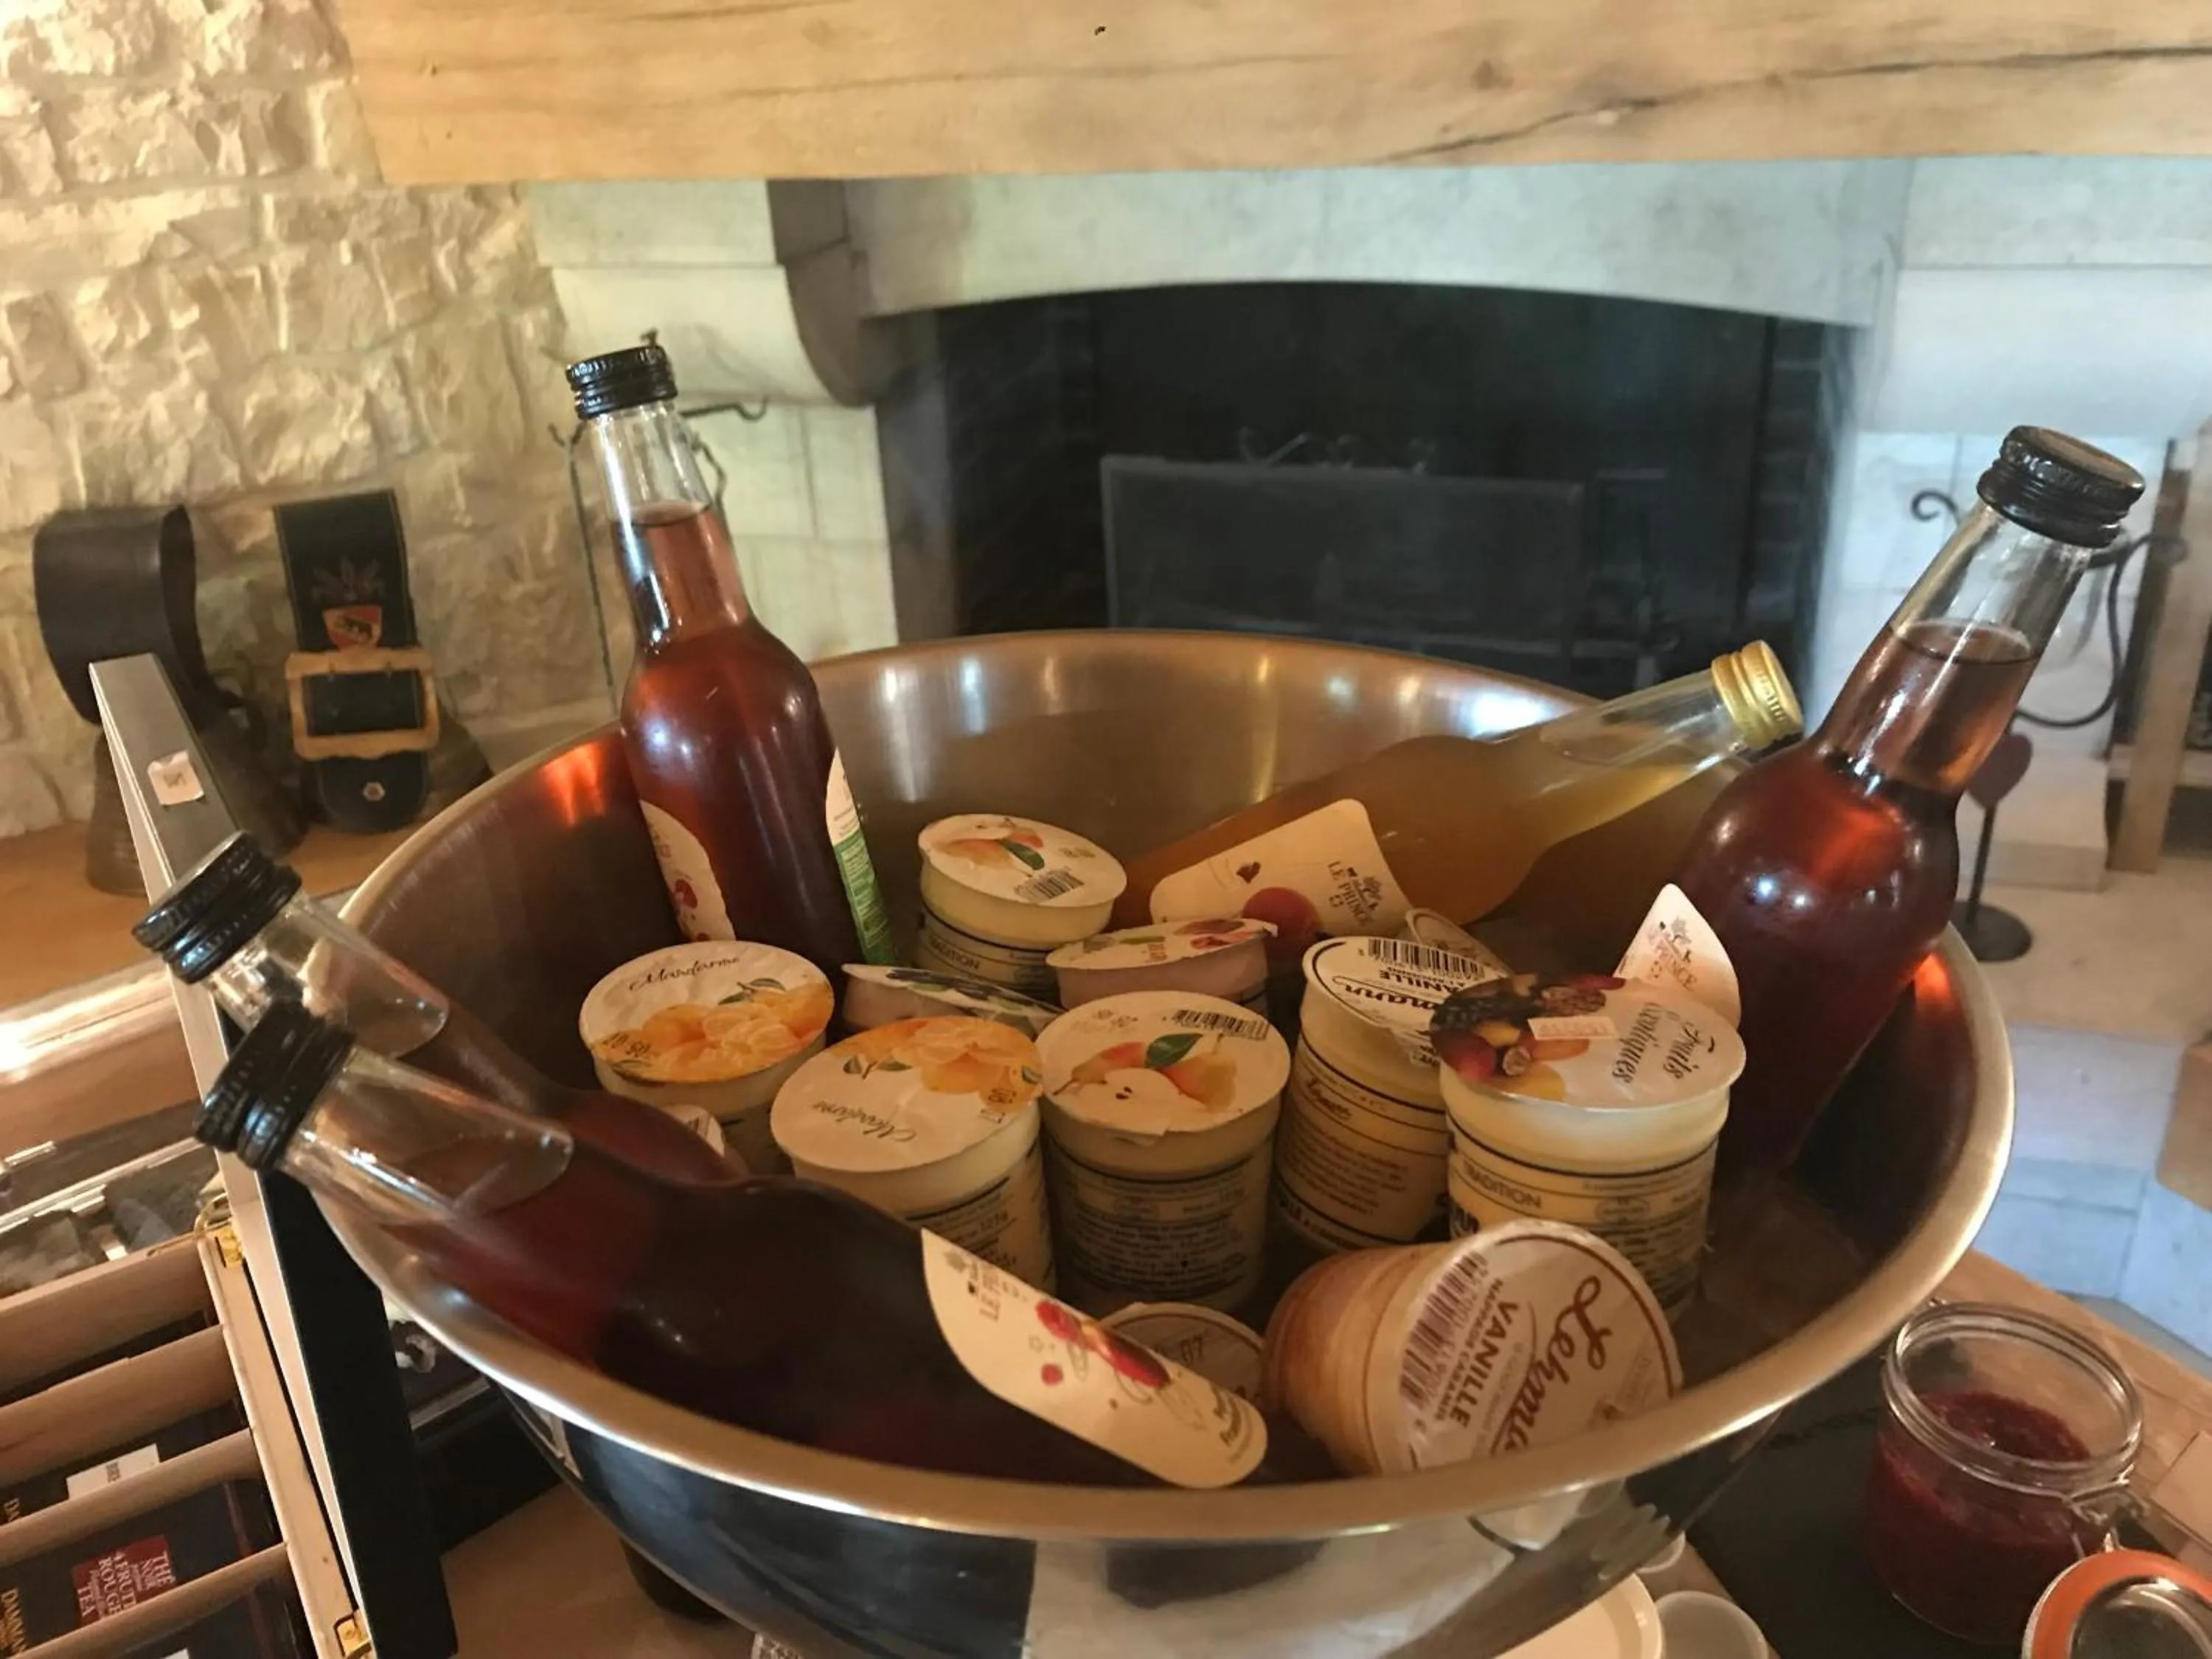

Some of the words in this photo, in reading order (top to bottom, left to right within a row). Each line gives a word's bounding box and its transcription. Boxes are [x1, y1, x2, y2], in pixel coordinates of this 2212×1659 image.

[1378, 970, 1458, 994] ANILLE
[1450, 1300, 1519, 1429] VANILLE
[77, 1585, 97, 1618] TEA
